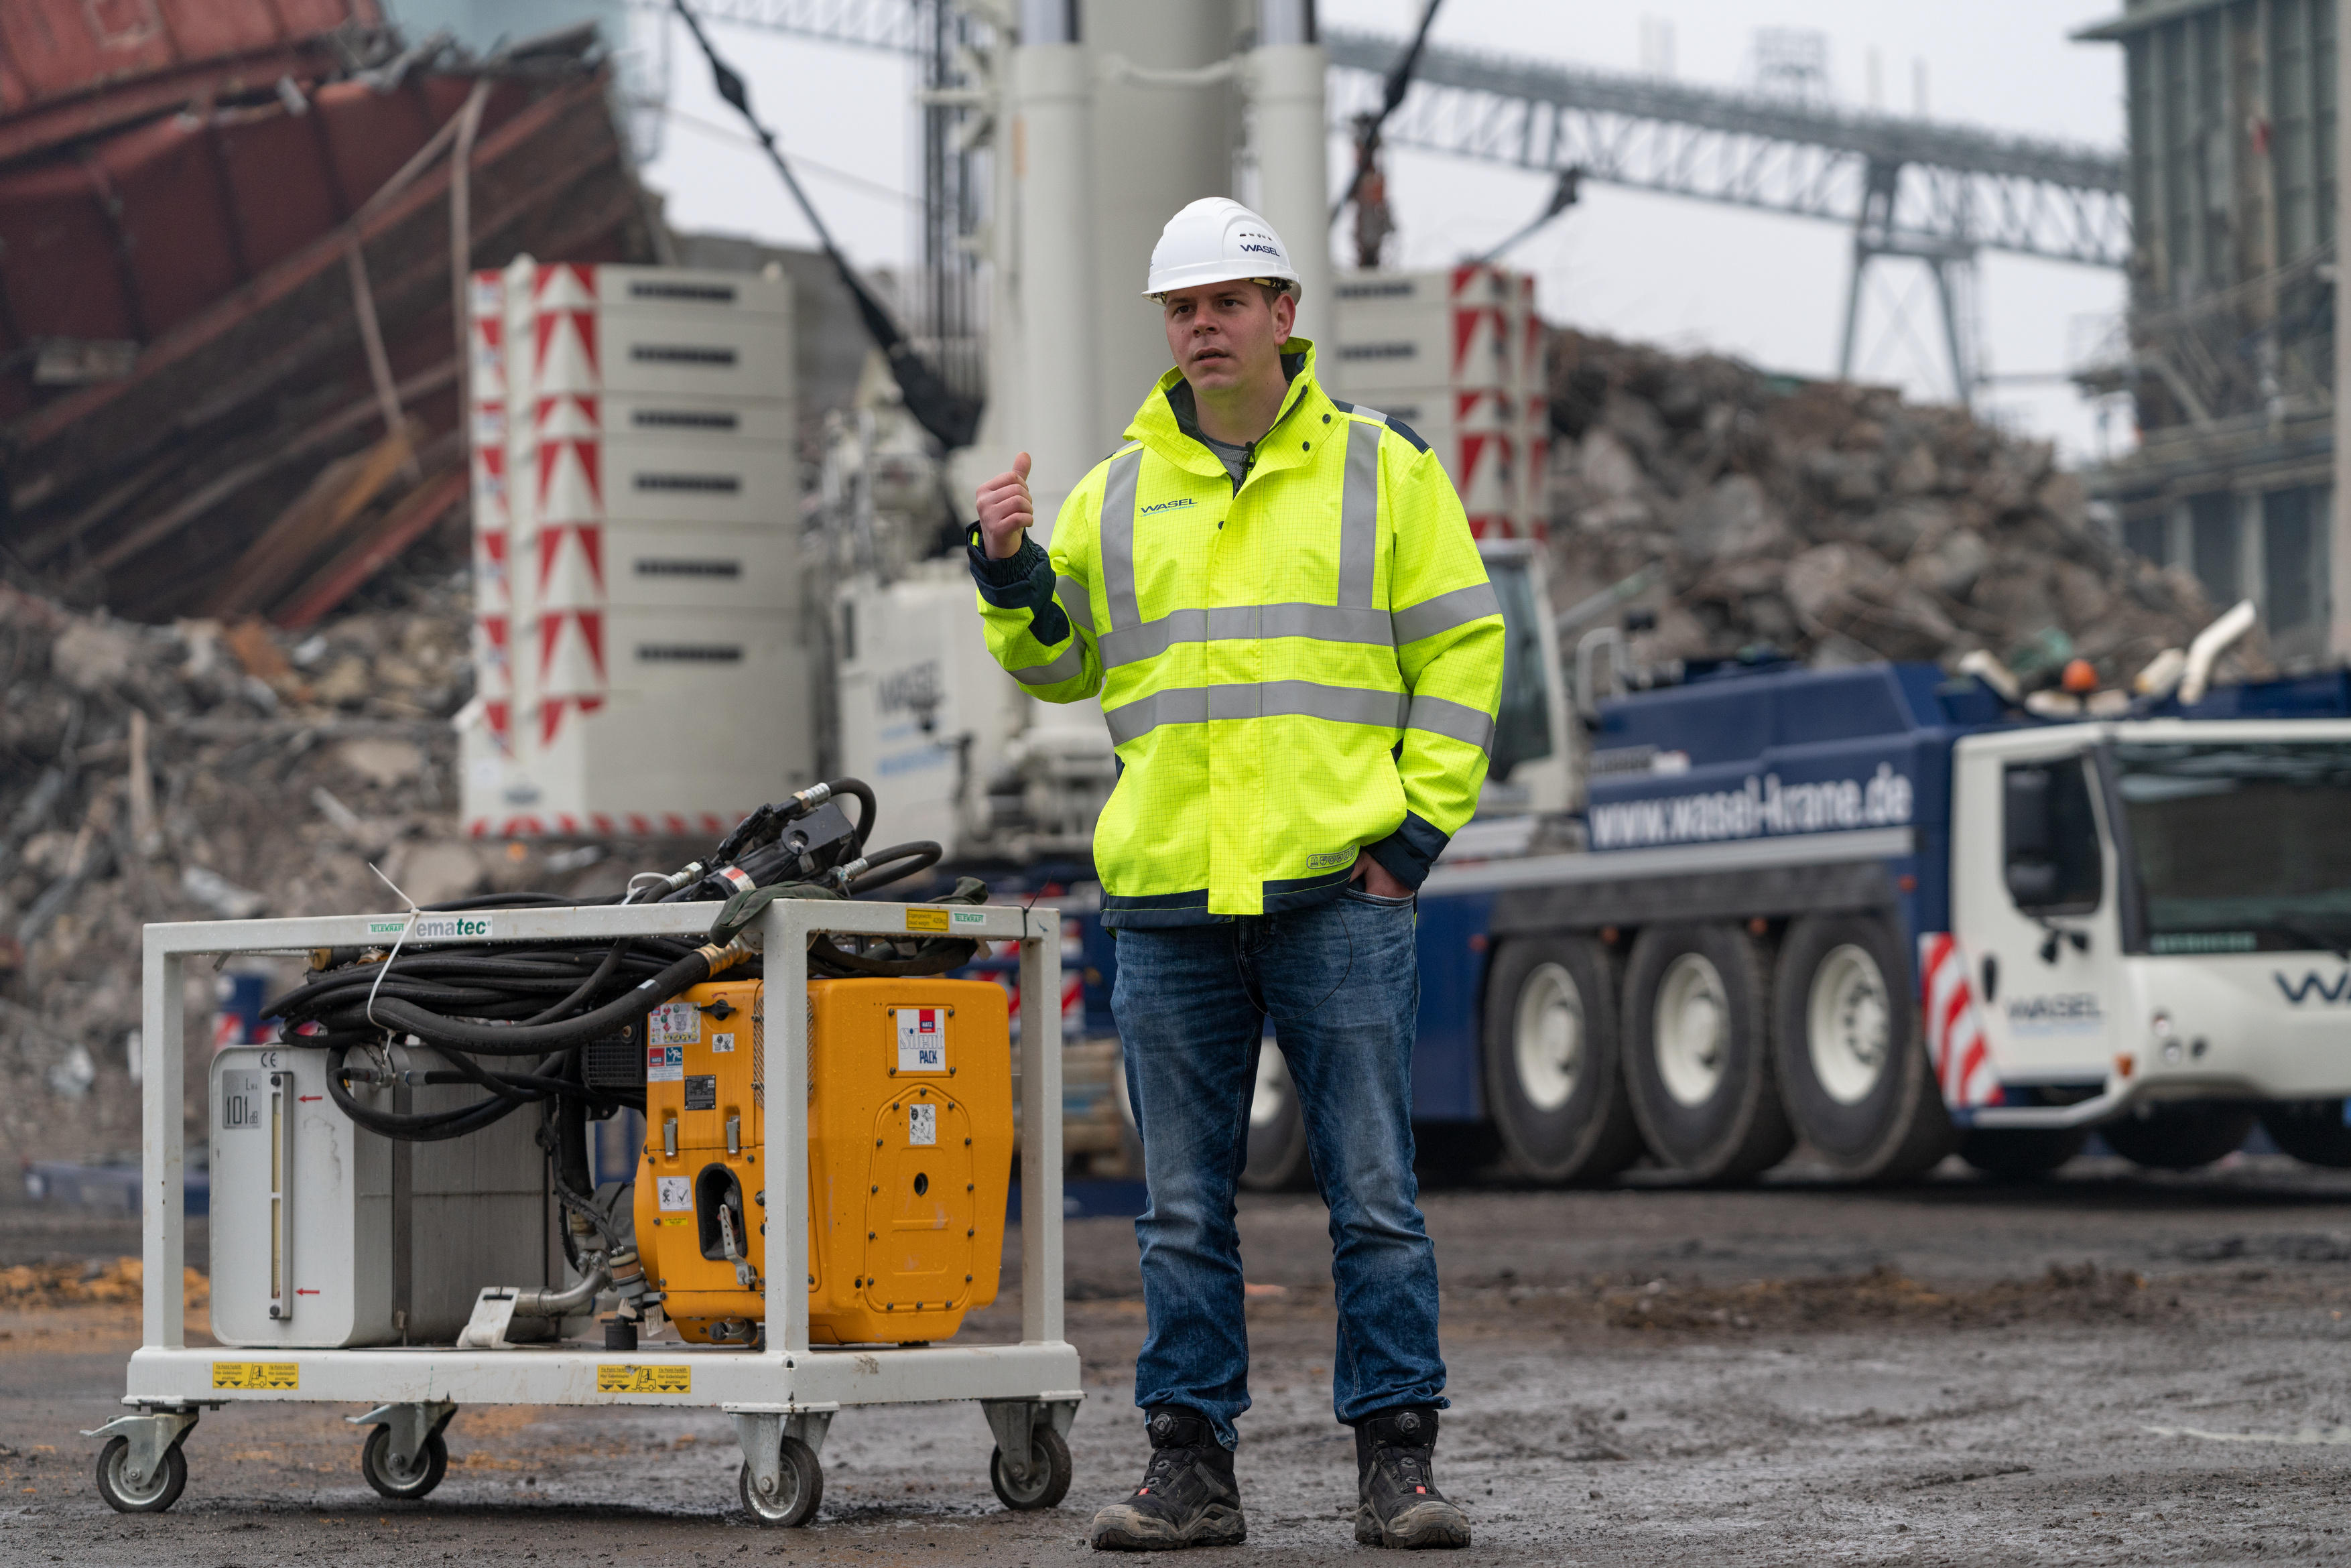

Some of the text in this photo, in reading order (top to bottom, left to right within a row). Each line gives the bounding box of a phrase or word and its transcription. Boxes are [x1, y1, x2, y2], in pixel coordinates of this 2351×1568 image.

[1240, 245, 1280, 257] WASEL
[1141, 499, 1198, 513] WASEL
[1590, 761, 1913, 849] www.wasel-krane.de
[954, 913, 984, 923] TELEKRAFT
[370, 923, 405, 933] TELEKRAFT
[2274, 970, 2351, 1005] W
[2010, 994, 2102, 1020] WASEL
[899, 1027, 944, 1049] Silent
[919, 1050, 938, 1064] PACK
[227, 1096, 248, 1124] 101
